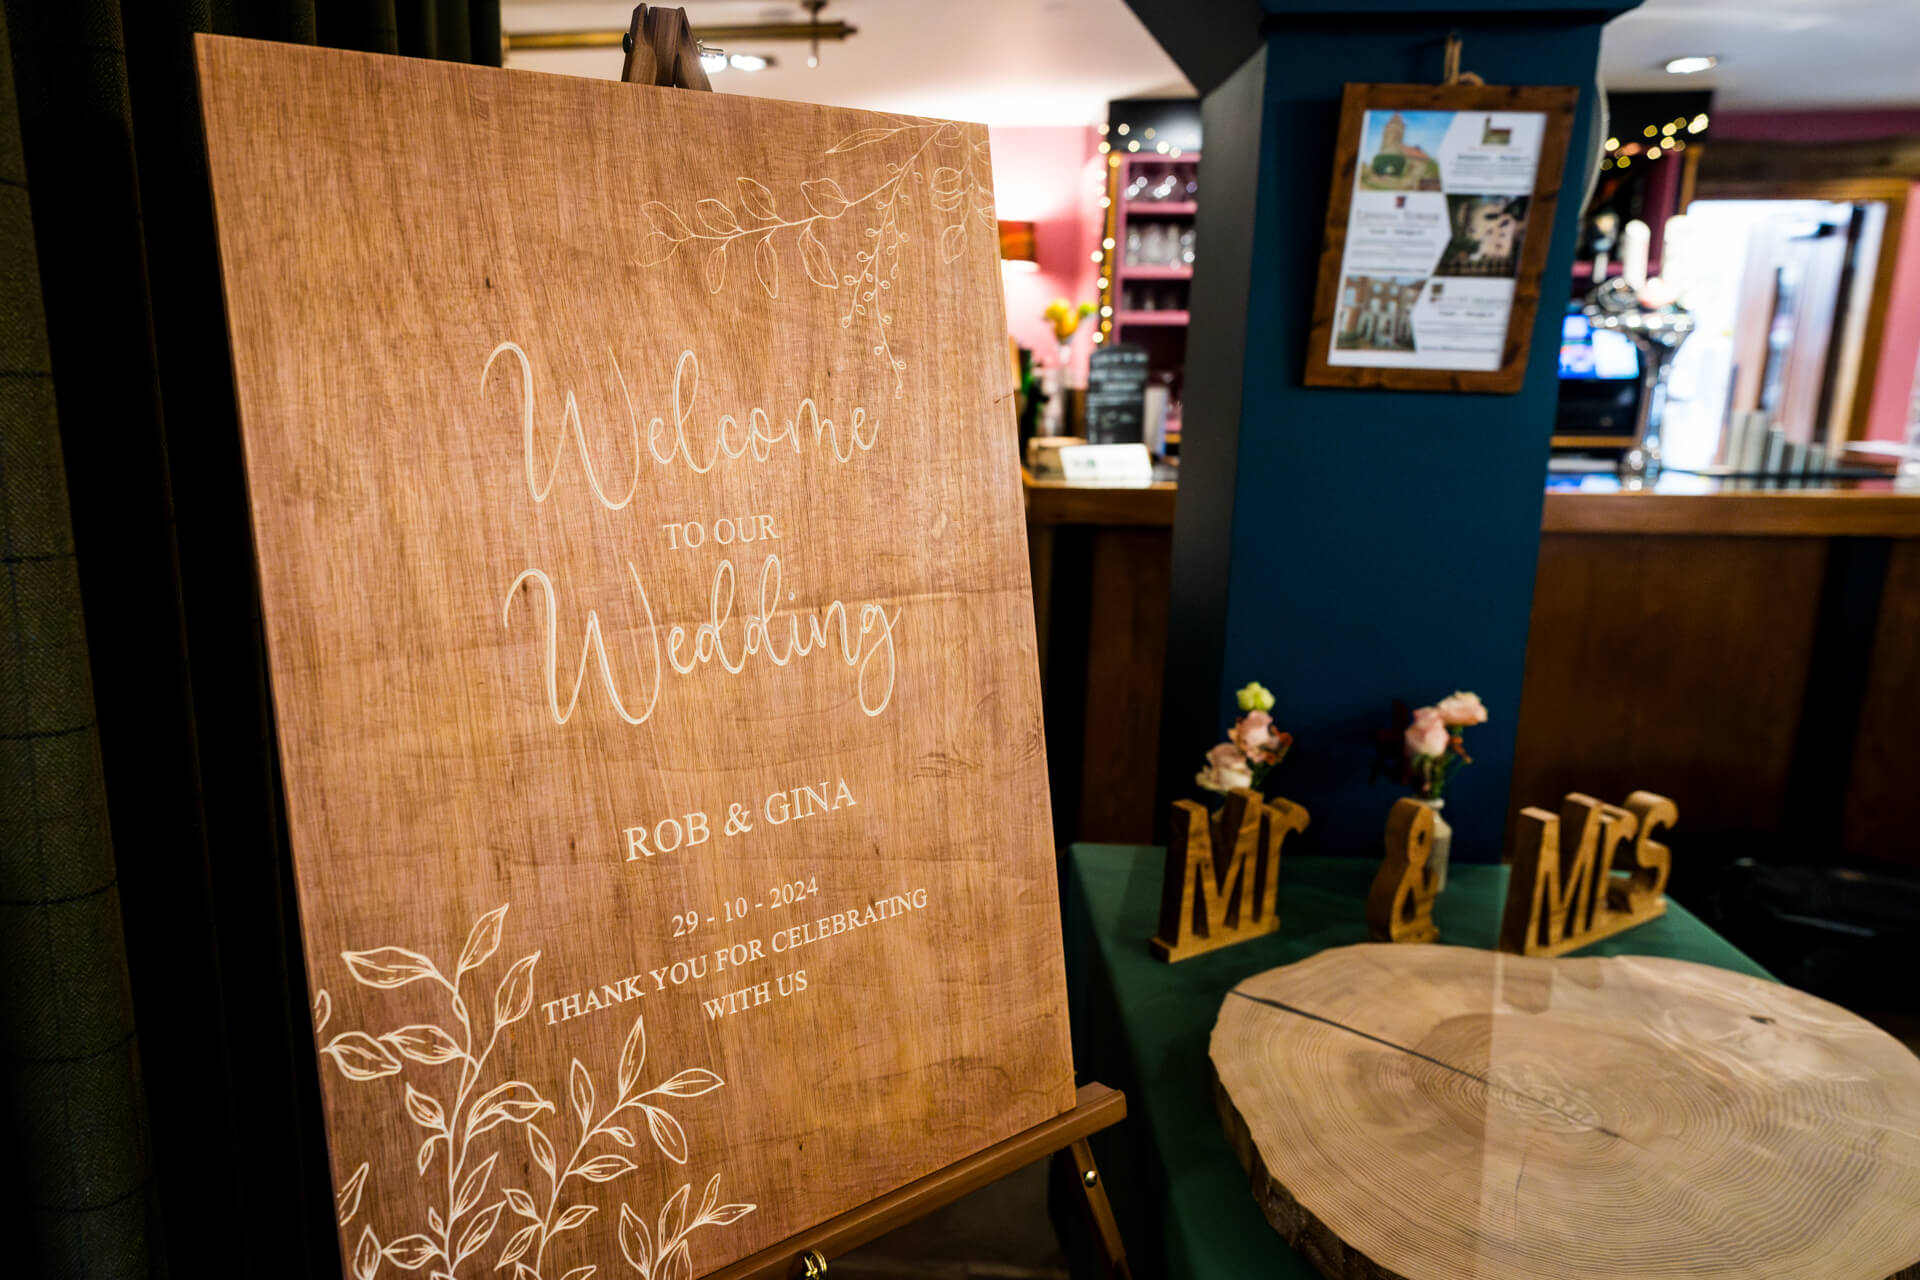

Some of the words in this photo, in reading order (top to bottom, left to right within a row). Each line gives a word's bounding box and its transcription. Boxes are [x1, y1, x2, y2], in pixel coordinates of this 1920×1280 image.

[480, 341, 880, 511] Welcome
[663, 522, 705, 550] TO
[713, 514, 779, 545] OUR
[503, 553, 902, 724] Wedding
[623, 811, 711, 862] ROB
[723, 802, 753, 837] &
[763, 778, 857, 825] GINA
[1157, 787, 1310, 944] Mr
[1368, 797, 1441, 944] &
[1502, 789, 1679, 956] Mrs
[541, 975, 645, 1026] THANK
[649, 955, 709, 993] YOU
[715, 939, 767, 973] FOR
[771, 888, 928, 953] CELEBRATING
[671, 911, 700, 938] 29
[725, 897, 748, 924] 10
[769, 877, 819, 911] 2024
[703, 982, 771, 1022] WITH
[776, 970, 808, 999] US
